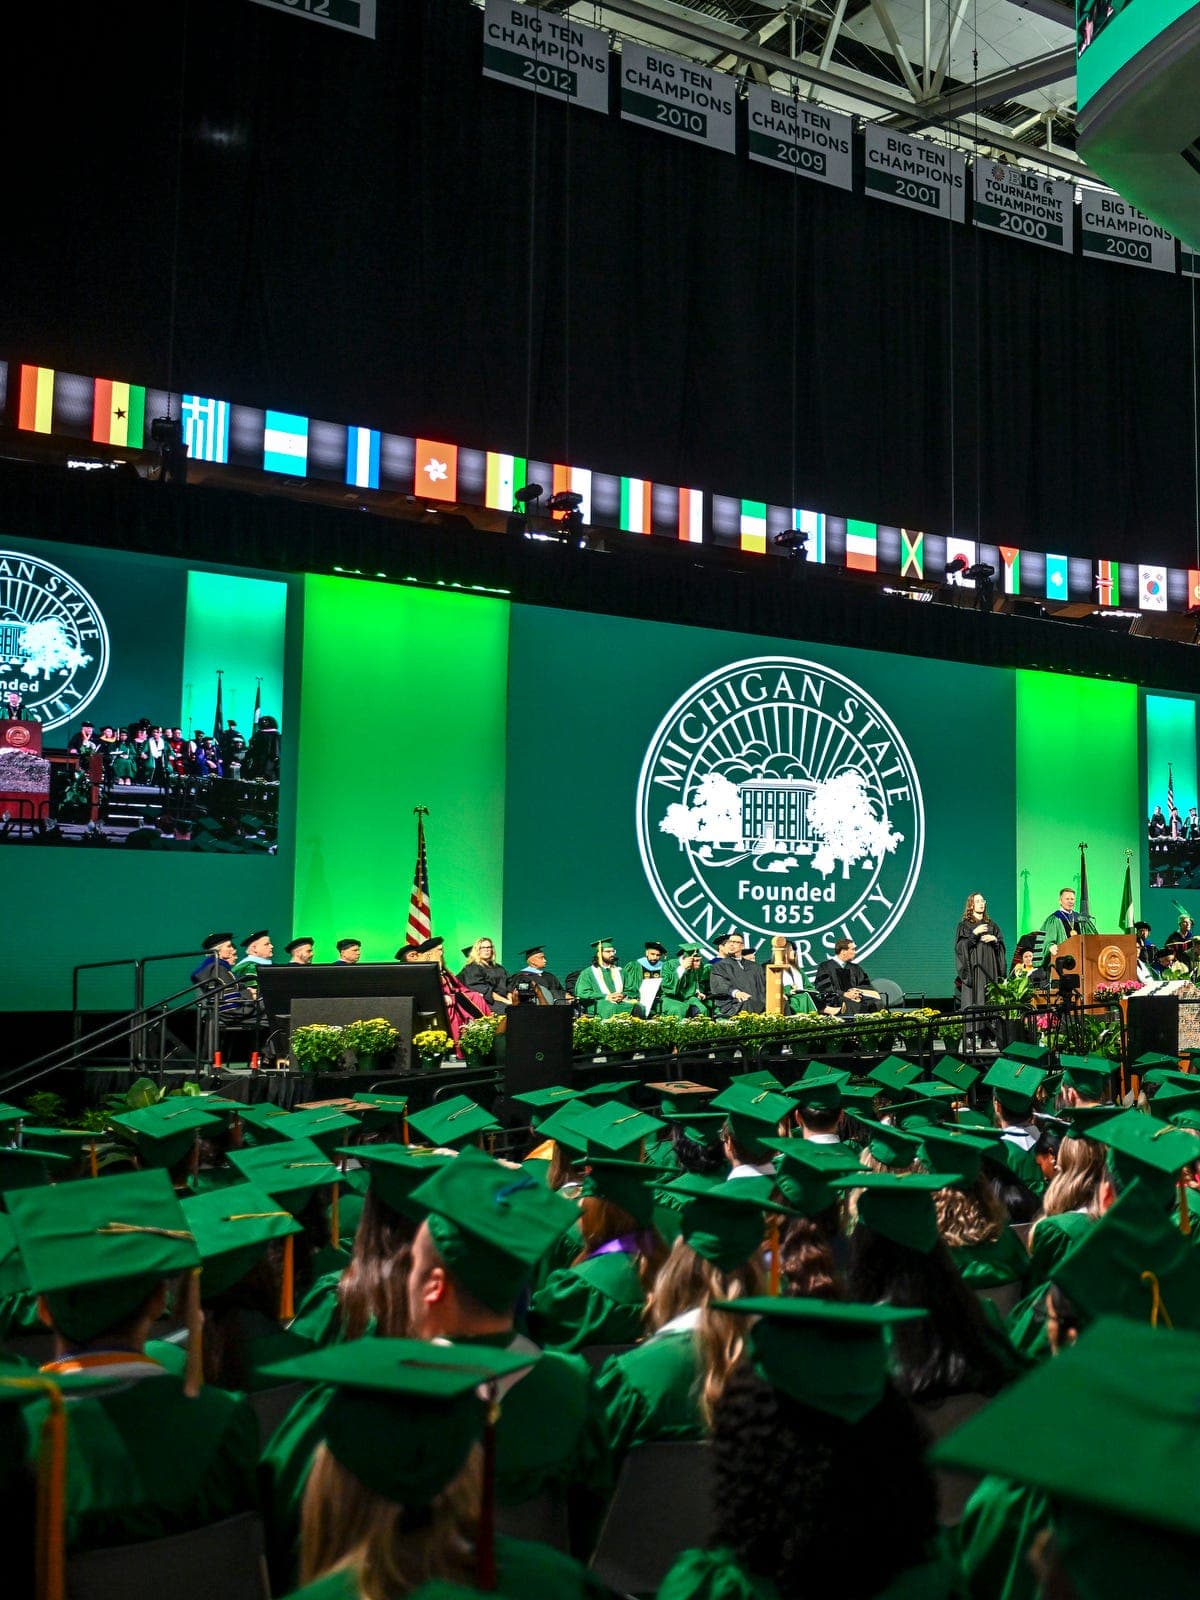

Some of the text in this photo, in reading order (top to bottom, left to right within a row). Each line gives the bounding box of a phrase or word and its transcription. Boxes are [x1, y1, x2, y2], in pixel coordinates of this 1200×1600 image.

[511, 10, 583, 47] BIG TEN
[488, 23, 605, 73] CHAMPIONS
[522, 61, 571, 91] 2012
[646, 56, 712, 91] BIG TEN
[625, 68, 732, 115] CHAMPIONS
[656, 104, 703, 132] 2010
[771, 99, 830, 131] BIG TEN
[752, 111, 849, 154] CHAMPIONS
[777, 143, 824, 171] 2009
[887, 137, 945, 167] BIG TEN
[868, 149, 963, 188] CHAMPIONS
[895, 180, 936, 204] 2001
[985, 178, 1063, 209] TOURNAMENT
[985, 191, 1063, 223] CHAMPIONS
[1101, 199, 1125, 215] BIG
[999, 212, 1048, 239] 2000
[1085, 212, 1172, 240] CHAMPIONS
[1106, 238, 1149, 259] 2000
[44, 576, 100, 641] STATE
[653, 670, 911, 806] MICHIGAN STATE
[738, 880, 836, 902] Founded
[762, 905, 815, 924] 1855
